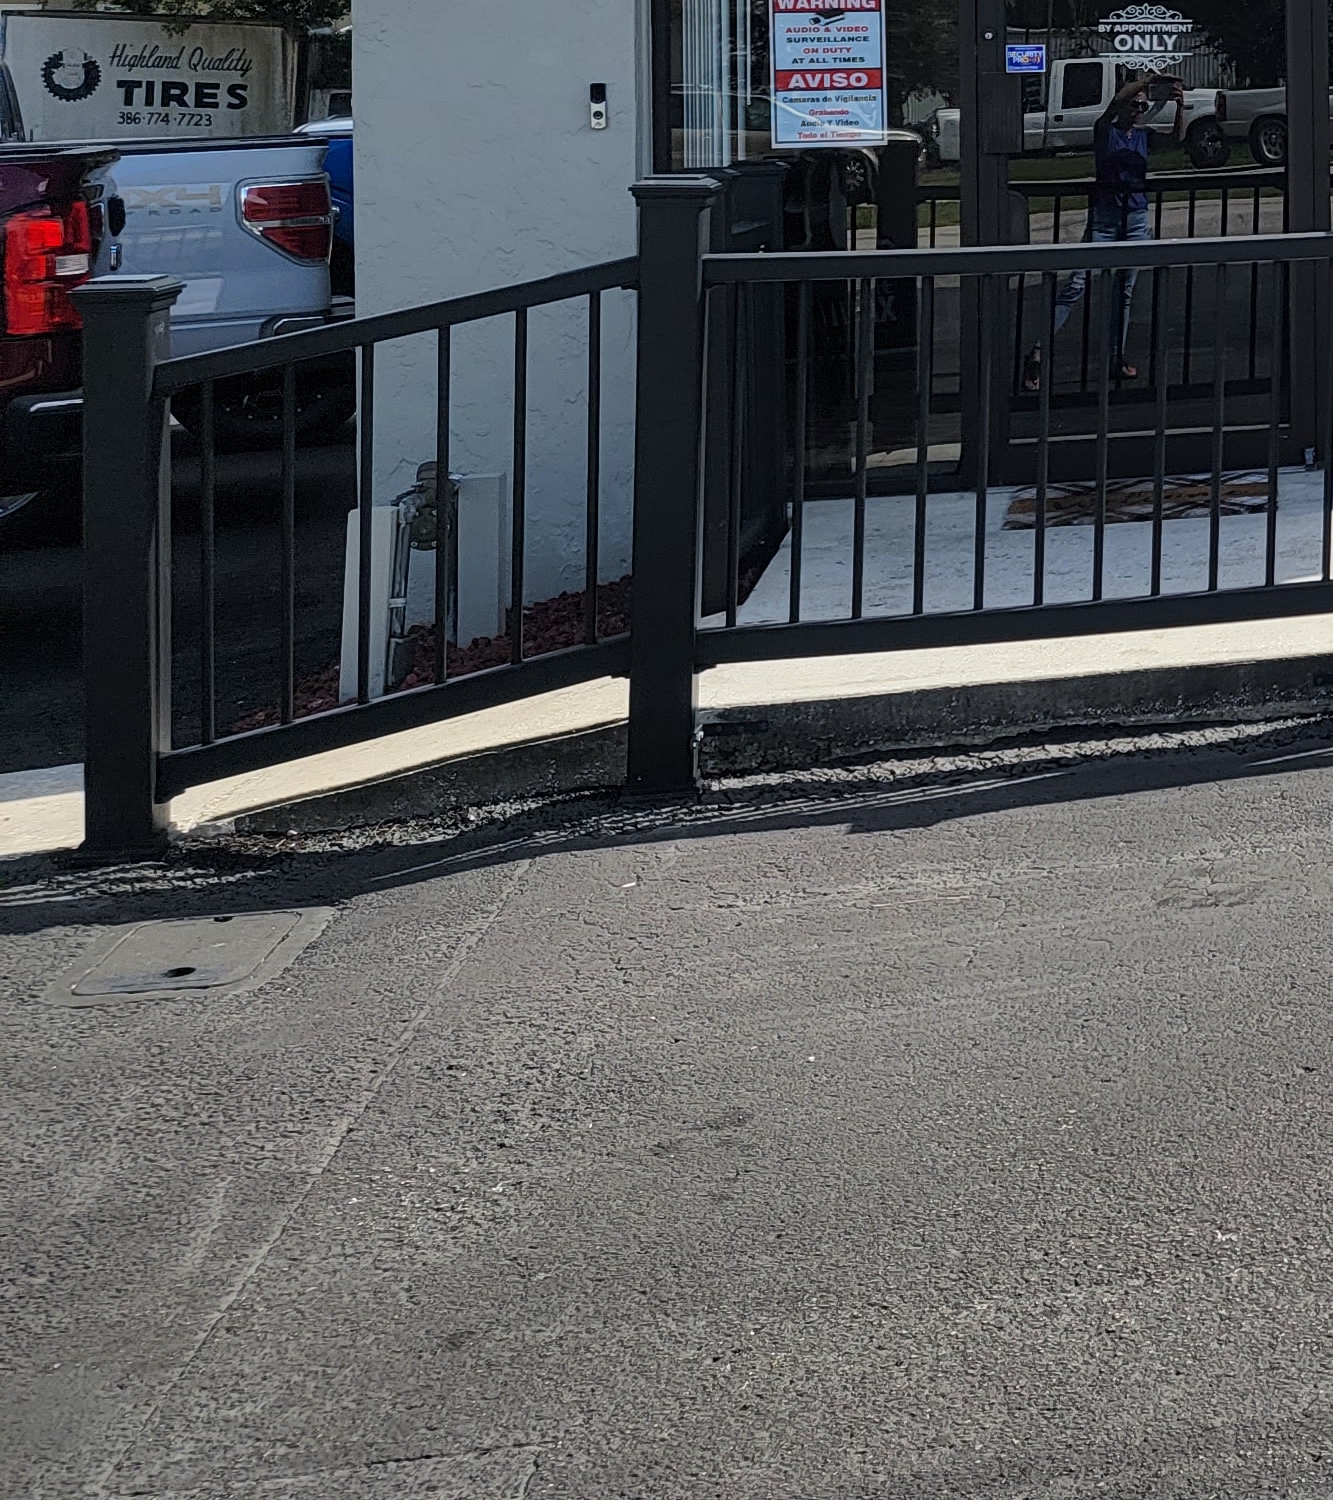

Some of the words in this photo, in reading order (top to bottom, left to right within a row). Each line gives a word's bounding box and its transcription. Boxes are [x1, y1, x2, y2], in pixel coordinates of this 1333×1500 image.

[785, 26, 820, 34] AUDIO
[835, 25, 869, 33] VIDEO
[1098, 24, 1113, 33] BY
[1113, 24, 1194, 33] APPOINTMENT
[786, 35, 870, 44] SURVEILLANCE
[1114, 34, 1178, 51] ONLY
[109, 43, 187, 72] Highland
[188, 46, 253, 78] Quality
[831, 56, 866, 64] TIMES
[787, 72, 869, 89] AVISO
[116, 79, 249, 110] TIRES
[834, 94, 877, 104] Vigilancia
[808, 108, 850, 117] Grabando
[834, 119, 860, 127] Video
[797, 131, 817, 139] Todo
[831, 130, 863, 139] Tiempo
